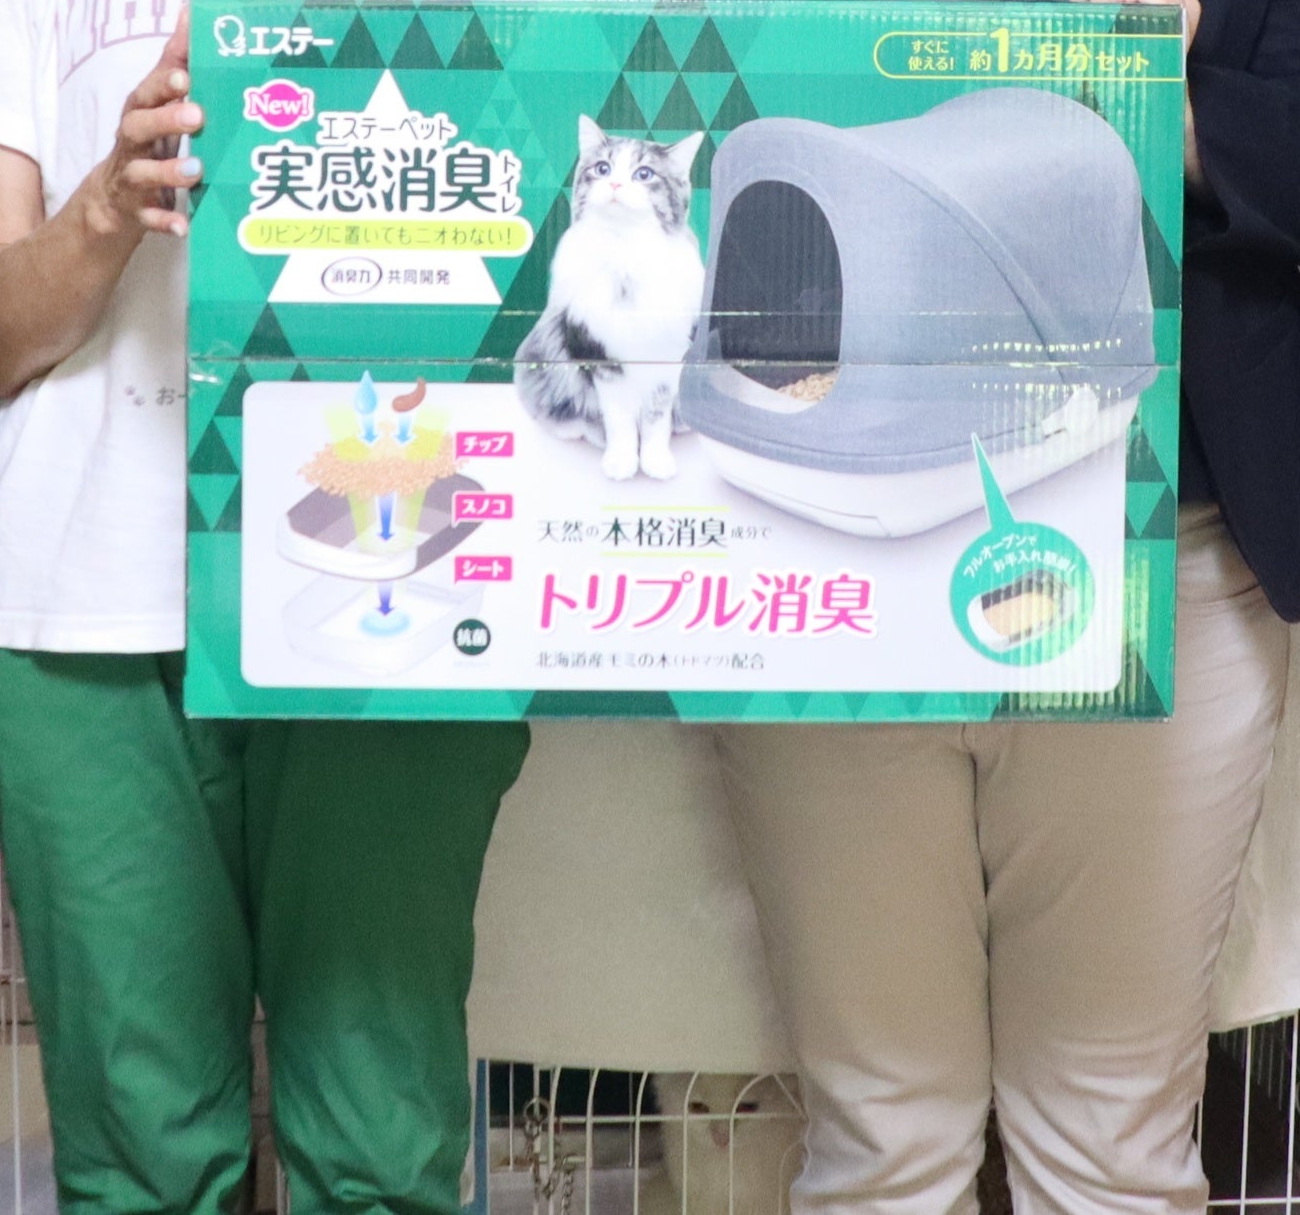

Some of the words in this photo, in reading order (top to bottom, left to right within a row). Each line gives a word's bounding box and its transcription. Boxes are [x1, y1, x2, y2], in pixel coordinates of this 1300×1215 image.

[249, 26, 334, 56] エステー
[910, 39, 949, 54] すぐに
[908, 56, 954, 72] 使える!
[249, 92, 310, 117] New!
[322, 115, 452, 141] エステーペット
[256, 145, 498, 214] 実感消臭
[501, 155, 517, 214] トイレ
[259, 224, 512, 246] リビングに置いてもニオわない!
[331, 268, 371, 284] 消臭力
[387, 268, 450, 285] 共同開発
[463, 434, 508, 454] チップ
[462, 499, 507, 516] スノコ
[462, 559, 504, 578] シート
[540, 570, 874, 634] トリプル消臭
